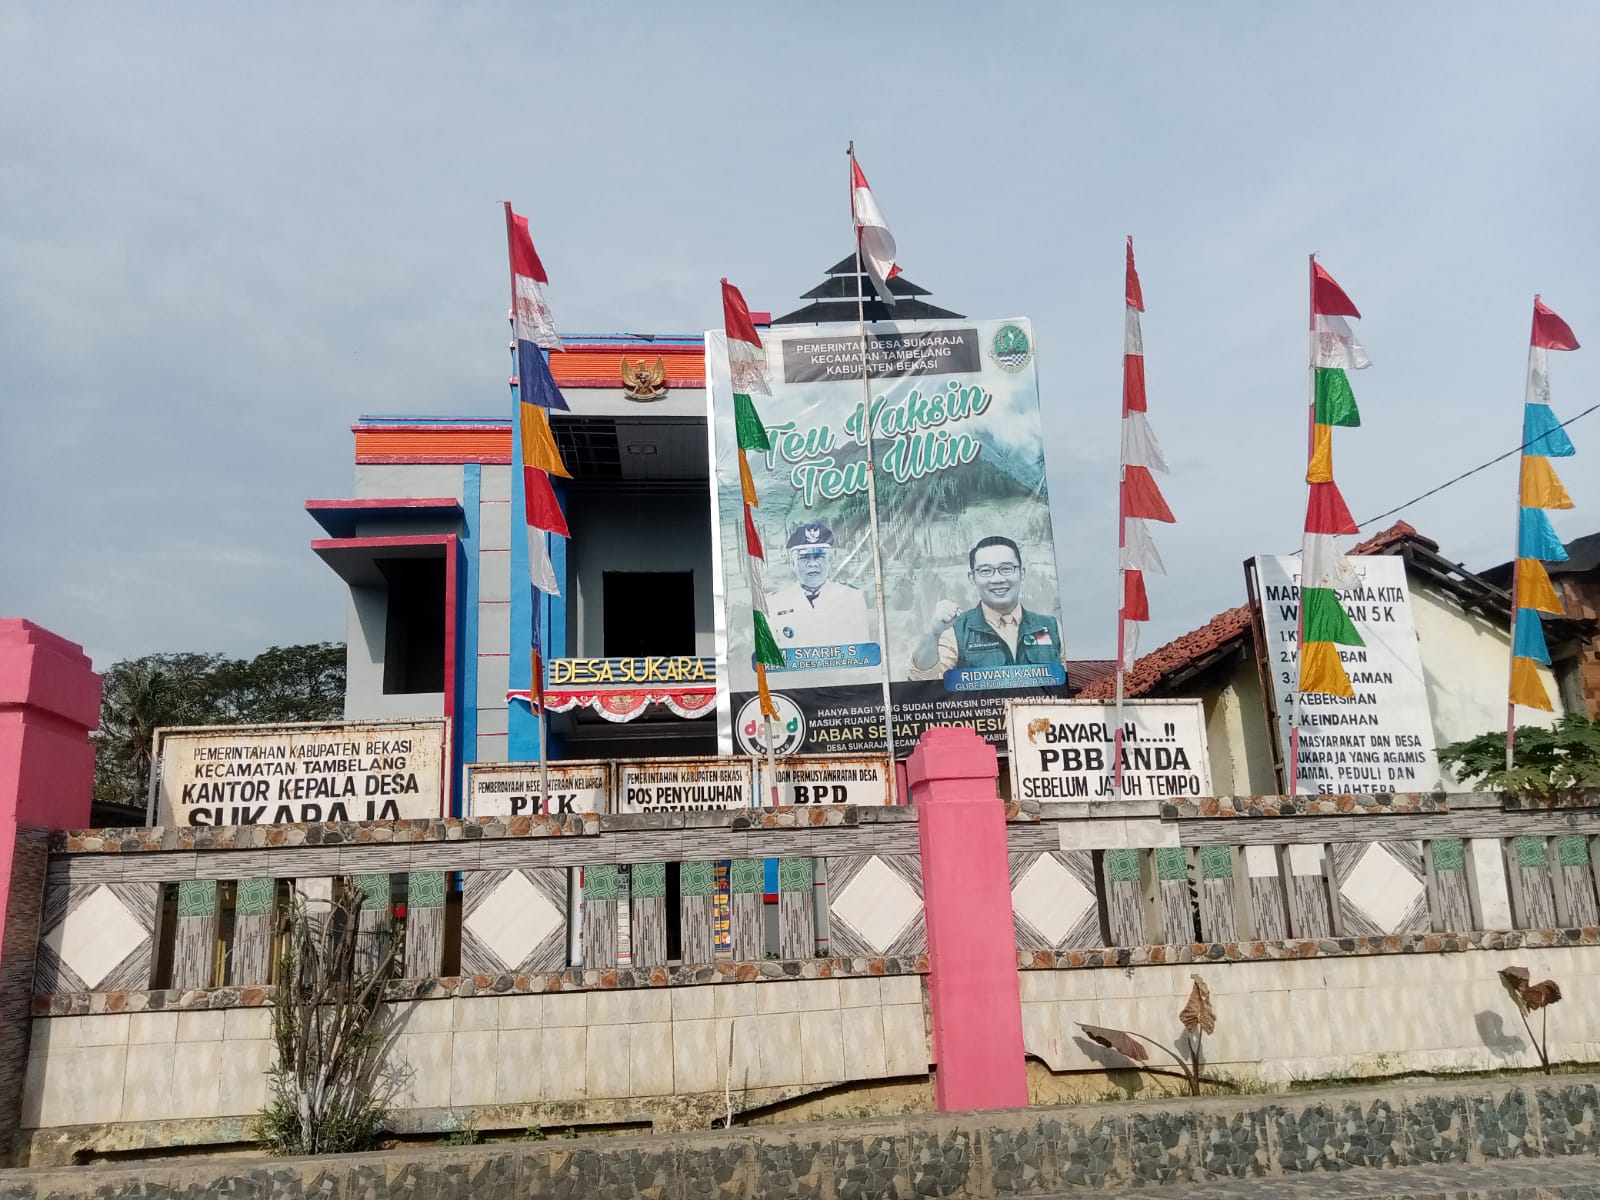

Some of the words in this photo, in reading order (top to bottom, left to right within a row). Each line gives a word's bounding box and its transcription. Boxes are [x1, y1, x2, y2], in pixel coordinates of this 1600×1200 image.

[871, 340, 900, 350] DESA
[904, 336, 964, 348] SUKARAJA
[811, 352, 879, 365] KECAMATAN
[883, 347, 951, 360] TAMBELANG
[826, 363, 893, 375] KABUPATEN
[896, 360, 938, 372] BEKASI
[765, 421, 836, 469] Teu
[844, 380, 992, 446] Vaksin
[791, 457, 869, 508] Teu
[882, 430, 981, 483] Ulin
[1266, 586, 1301, 601] MAR
[1378, 587, 1405, 603] KITA
[555, 659, 614, 683] DESA
[620, 657, 716, 682] SUKARA
[799, 660, 821, 669] DESA
[823, 658, 870, 667] SUKARAJA
[961, 670, 1011, 682] RIDWAN
[1014, 667, 1053, 678] KAMIL
[817, 706, 849, 718] HANYA
[851, 705, 874, 716] BAGI
[875, 704, 901, 715] YAG
[902, 701, 934, 712] SUDAH
[935, 699, 978, 711] DIVAKSIN
[809, 718, 841, 728] MASUK
[844, 716, 877, 727] RUANG
[879, 713, 913, 724] PBLIK
[914, 712, 934, 722] DAN
[936, 709, 973, 720] TUJUAN
[809, 726, 863, 743] JABAR
[868, 722, 921, 739] SEHAT
[1299, 735, 1366, 748] MASYARAKAT
[1371, 735, 1391, 748] DAN
[1395, 735, 1422, 748] DESA
[194, 745, 286, 761] PEMERINTAHAN
[290, 742, 360, 759] KABUPATEN
[366, 740, 412, 755] BEKASI
[826, 743, 848, 752] DESA
[848, 740, 888, 751] SUKARAJA
[195, 761, 296, 779] KECAMATAN
[303, 756, 406, 775] TAMBELANG
[1038, 748, 1105, 772] PBB
[1112, 747, 1192, 771] ANDA
[1297, 752, 1346, 765] UKARAJA
[1350, 752, 1380, 764] YANG
[1383, 752, 1426, 764] AGAMIS
[627, 771, 678, 785] PEMERINTAHAN
[681, 770, 718, 783] KABUPATEN
[720, 769, 742, 782] BEKASI
[793, 769, 858, 782] PERMUSYAWARATAN
[860, 769, 878, 781] DESA
[1339, 767, 1381, 780] PEDULI
[1389, 767, 1416, 780] DAN
[182, 780, 270, 805] KANTOR
[278, 776, 357, 802] KEPALA
[365, 773, 419, 796] DESA
[478, 780, 524, 793] PEMBERDAYAAN
[574, 776, 603, 790] KELUARGA
[1023, 776, 1089, 798] SEBELUM
[1095, 776, 1142, 797] JAUH
[1146, 775, 1201, 796] TEMPO
[627, 787, 652, 805] POS
[656, 785, 743, 804] PENYULUHAN
[793, 785, 848, 804] BPD
